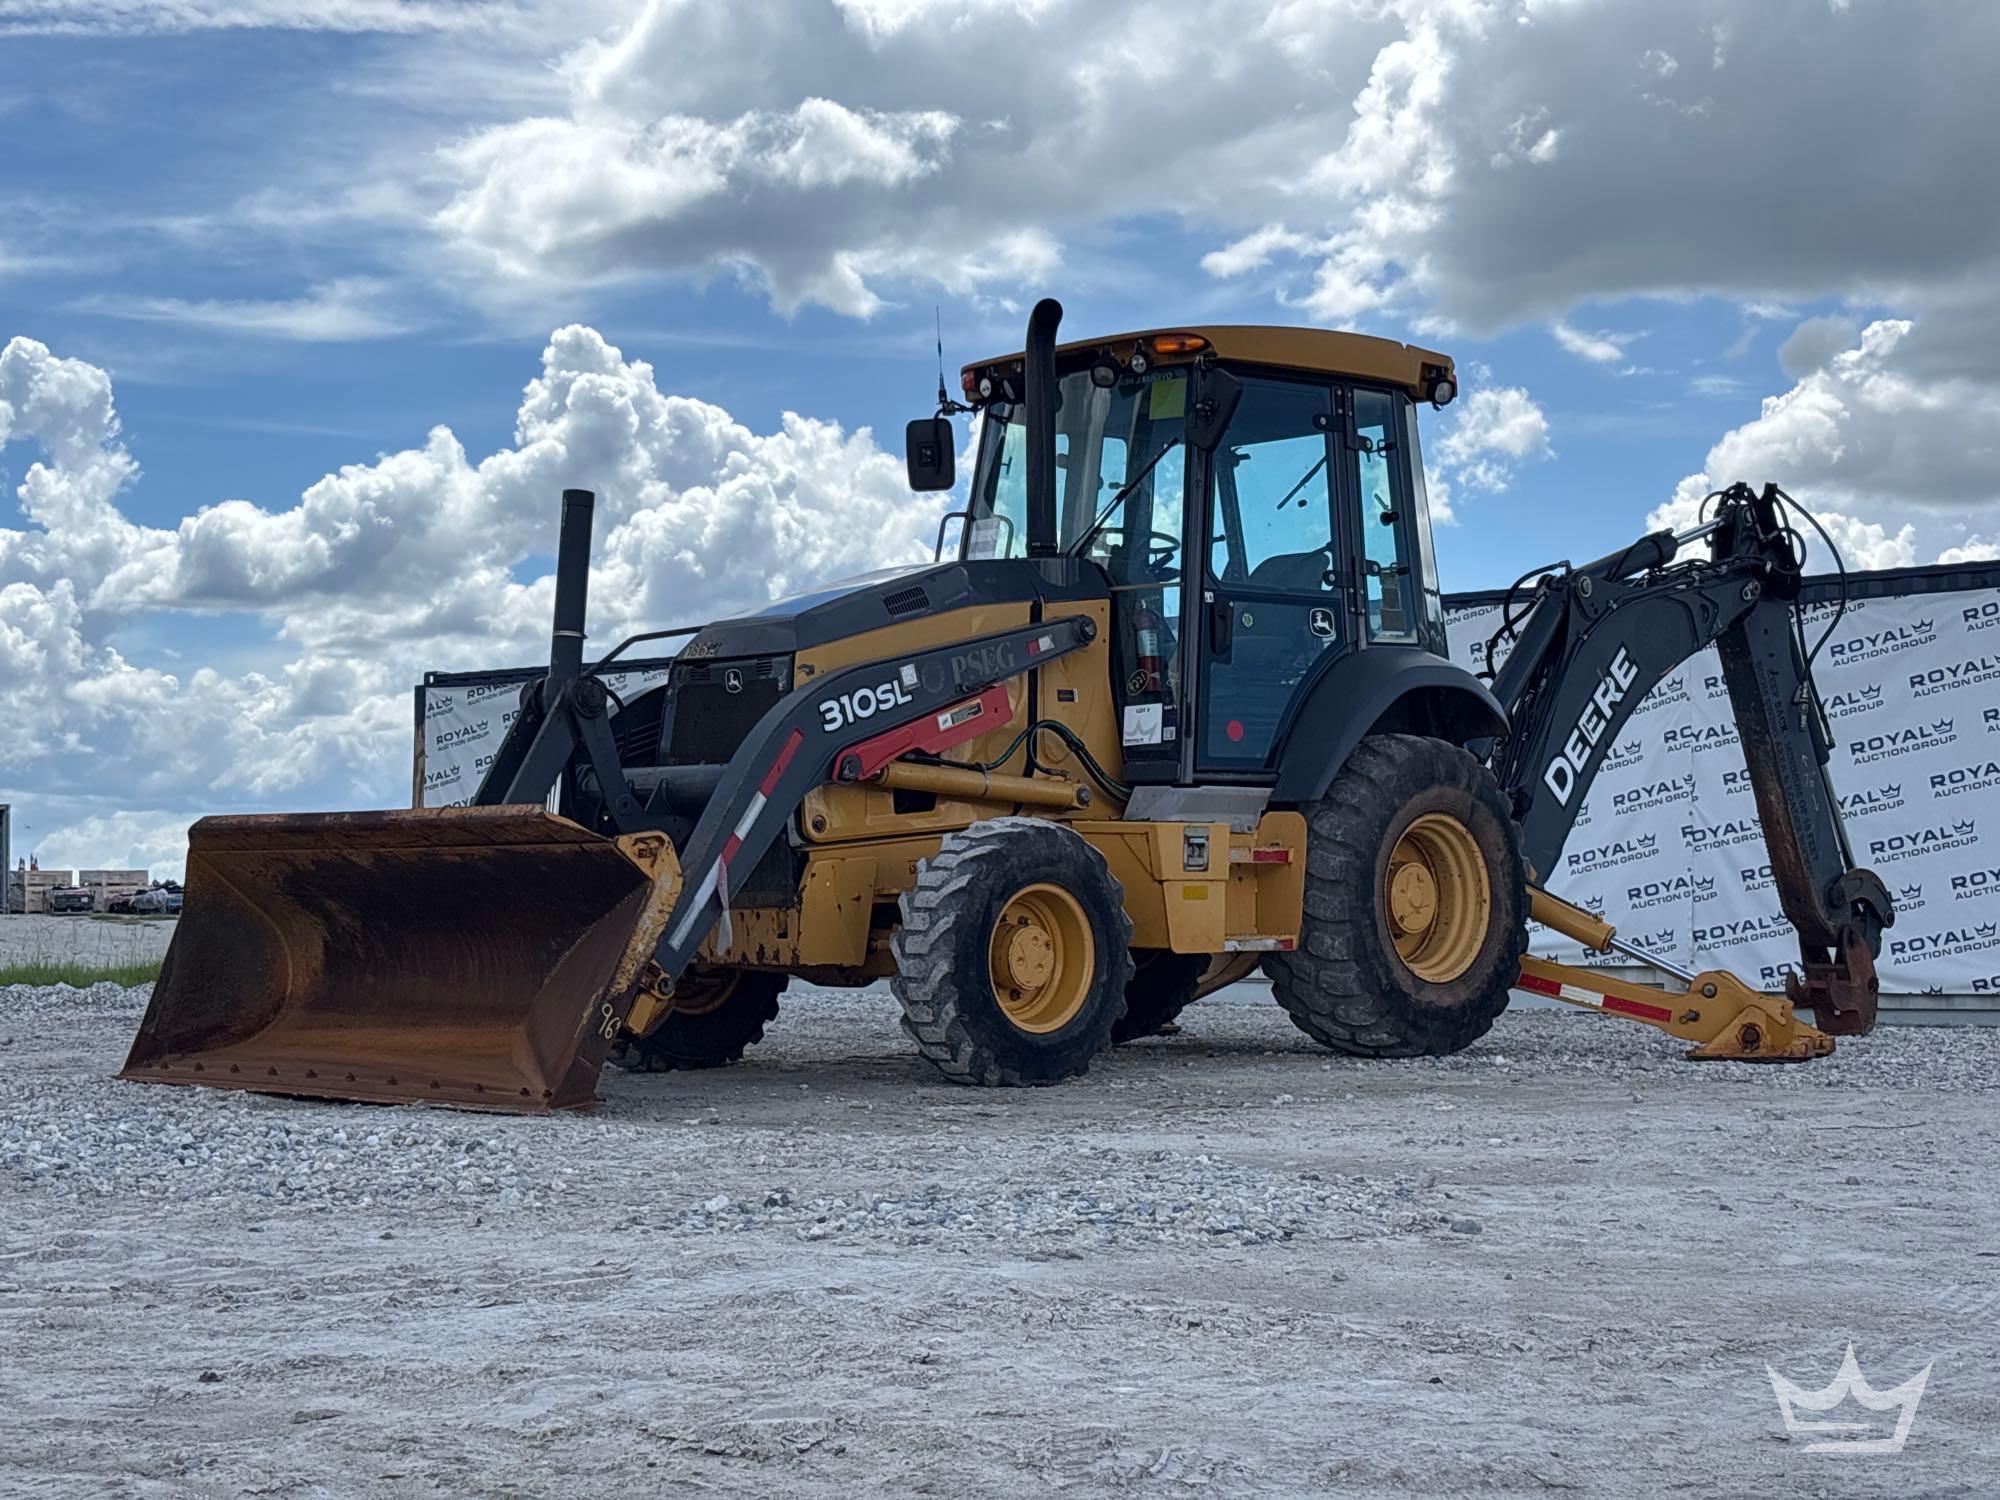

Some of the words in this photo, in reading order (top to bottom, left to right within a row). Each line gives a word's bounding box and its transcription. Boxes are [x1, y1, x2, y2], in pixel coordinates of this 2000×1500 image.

[1463, 605, 1500, 620] GROUP
[1830, 627, 1913, 658] ROYAL
[1833, 647, 1890, 668] AUCTION
[1891, 634, 1937, 652] GROUP
[1909, 657, 1996, 689] ROYAL
[1913, 677, 1972, 699] AUCTION
[1973, 670, 2000, 683] GRO
[467, 693, 498, 706] AUCTION
[498, 685, 522, 697] GROUP
[819, 681, 913, 732] 310SL
[1651, 692, 1688, 710] GROUP
[1840, 699, 1885, 717] GROUP
[432, 706, 455, 719] GROUP
[1543, 645, 1640, 804] DEERE
[436, 725, 477, 745] ROYAL
[437, 740, 466, 752] AUCTION
[467, 730, 490, 743] GROUP
[1714, 736, 1740, 748] GRO
[1850, 726, 1933, 756] ROYAL
[1853, 745, 1910, 766] AUCTION
[1911, 734, 1958, 752] GROUP
[1606, 755, 1644, 771] GROUP
[1929, 762, 2000, 789] ROYA
[424, 769, 451, 785] YAL
[440, 775, 462, 787] GROUP
[1934, 779, 1992, 799] AUCTION
[1613, 779, 1684, 807] ROYAL
[1837, 789, 1882, 810] YAL
[1615, 798, 1664, 816] AUCTION
[1860, 799, 1905, 816] GROUP
[1870, 826, 1954, 855] ROYAL
[1873, 846, 1930, 865] AUCTION
[1932, 836, 1979, 852] GROUP
[1567, 841, 1638, 867] ROYAL
[1570, 858, 1619, 876] AUCTION
[1620, 848, 1660, 864] GROUP
[1631, 893, 1681, 911] AUCTION
[1692, 917, 1771, 943] ROYAL
[1696, 935, 1749, 952] AUCTION
[1750, 927, 1794, 941] GROUP
[1890, 929, 1975, 956] ROYAL
[1893, 948, 1952, 966] AUCTION
[1953, 939, 2000, 954] GROUP
